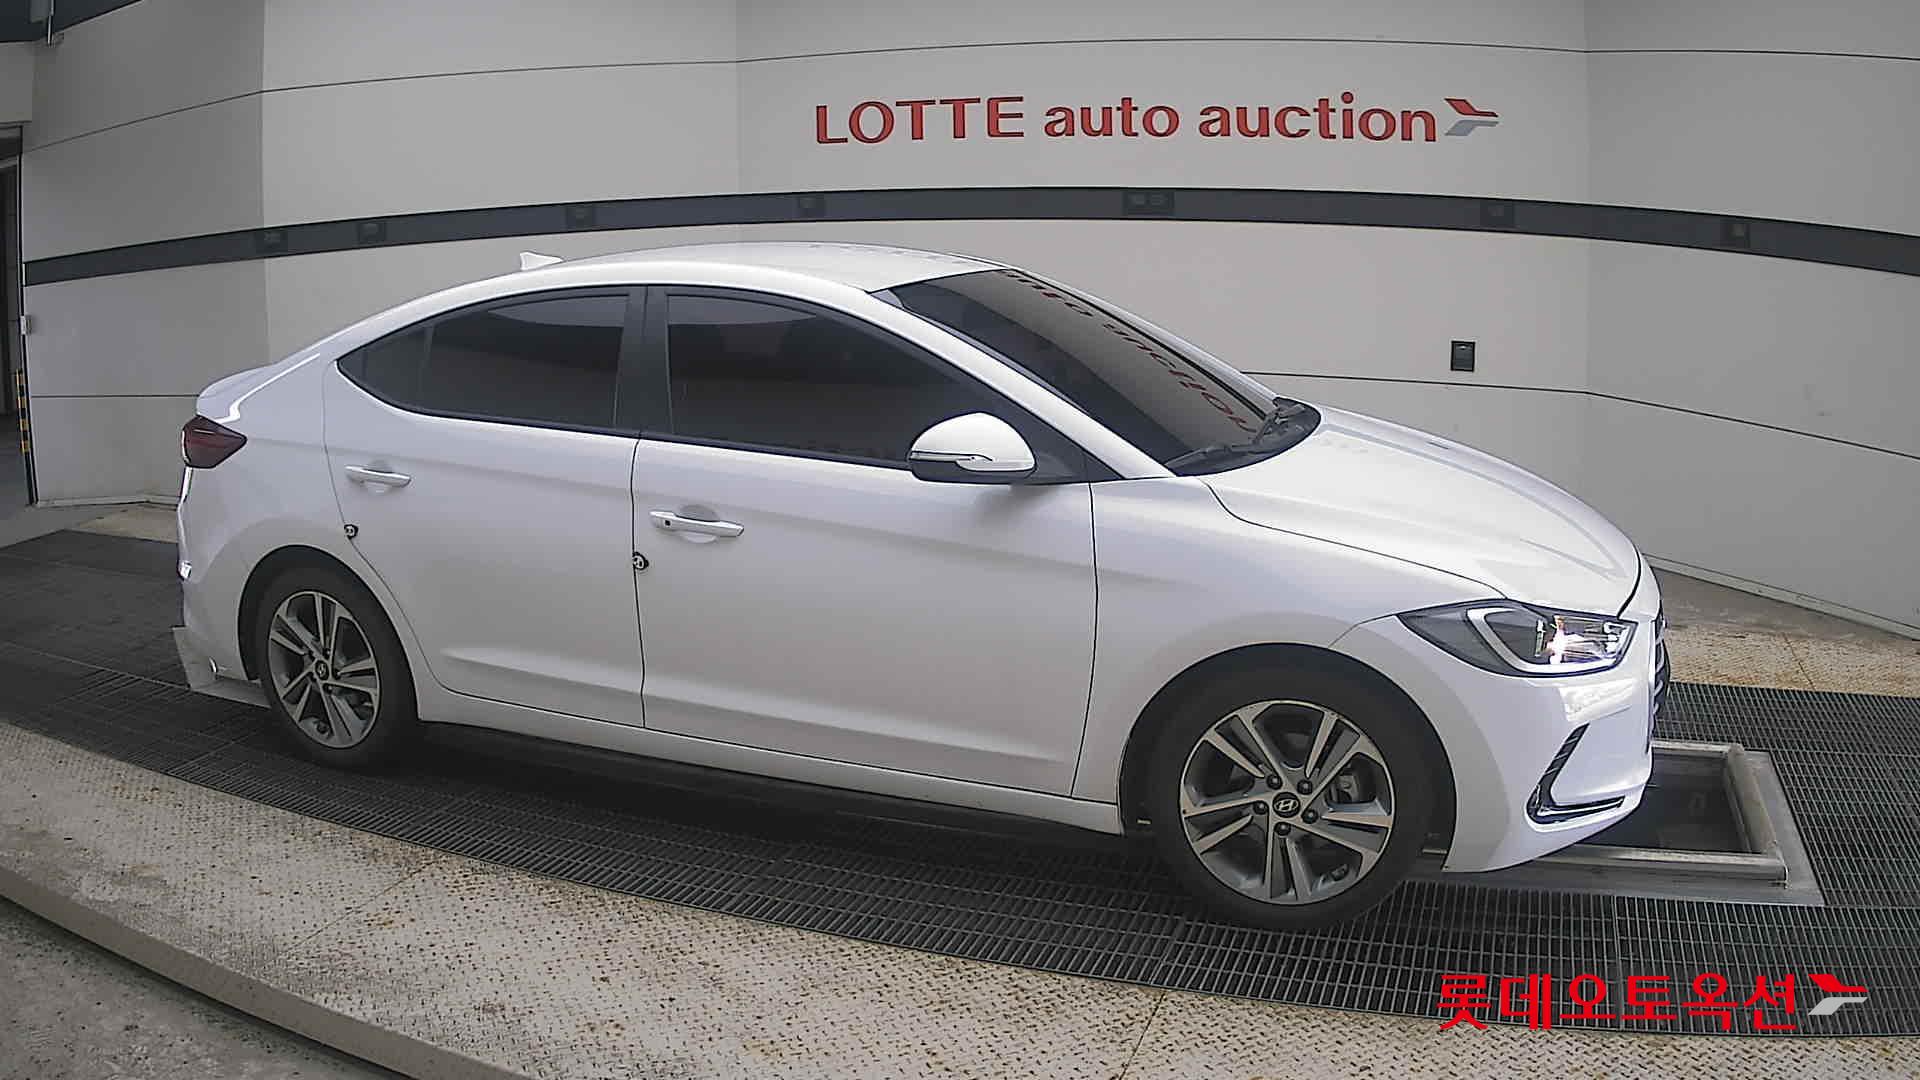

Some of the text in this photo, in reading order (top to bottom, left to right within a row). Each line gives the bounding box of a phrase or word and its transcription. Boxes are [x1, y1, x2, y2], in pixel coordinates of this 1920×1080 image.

[815, 91, 1438, 143] LOTTE auto auction
